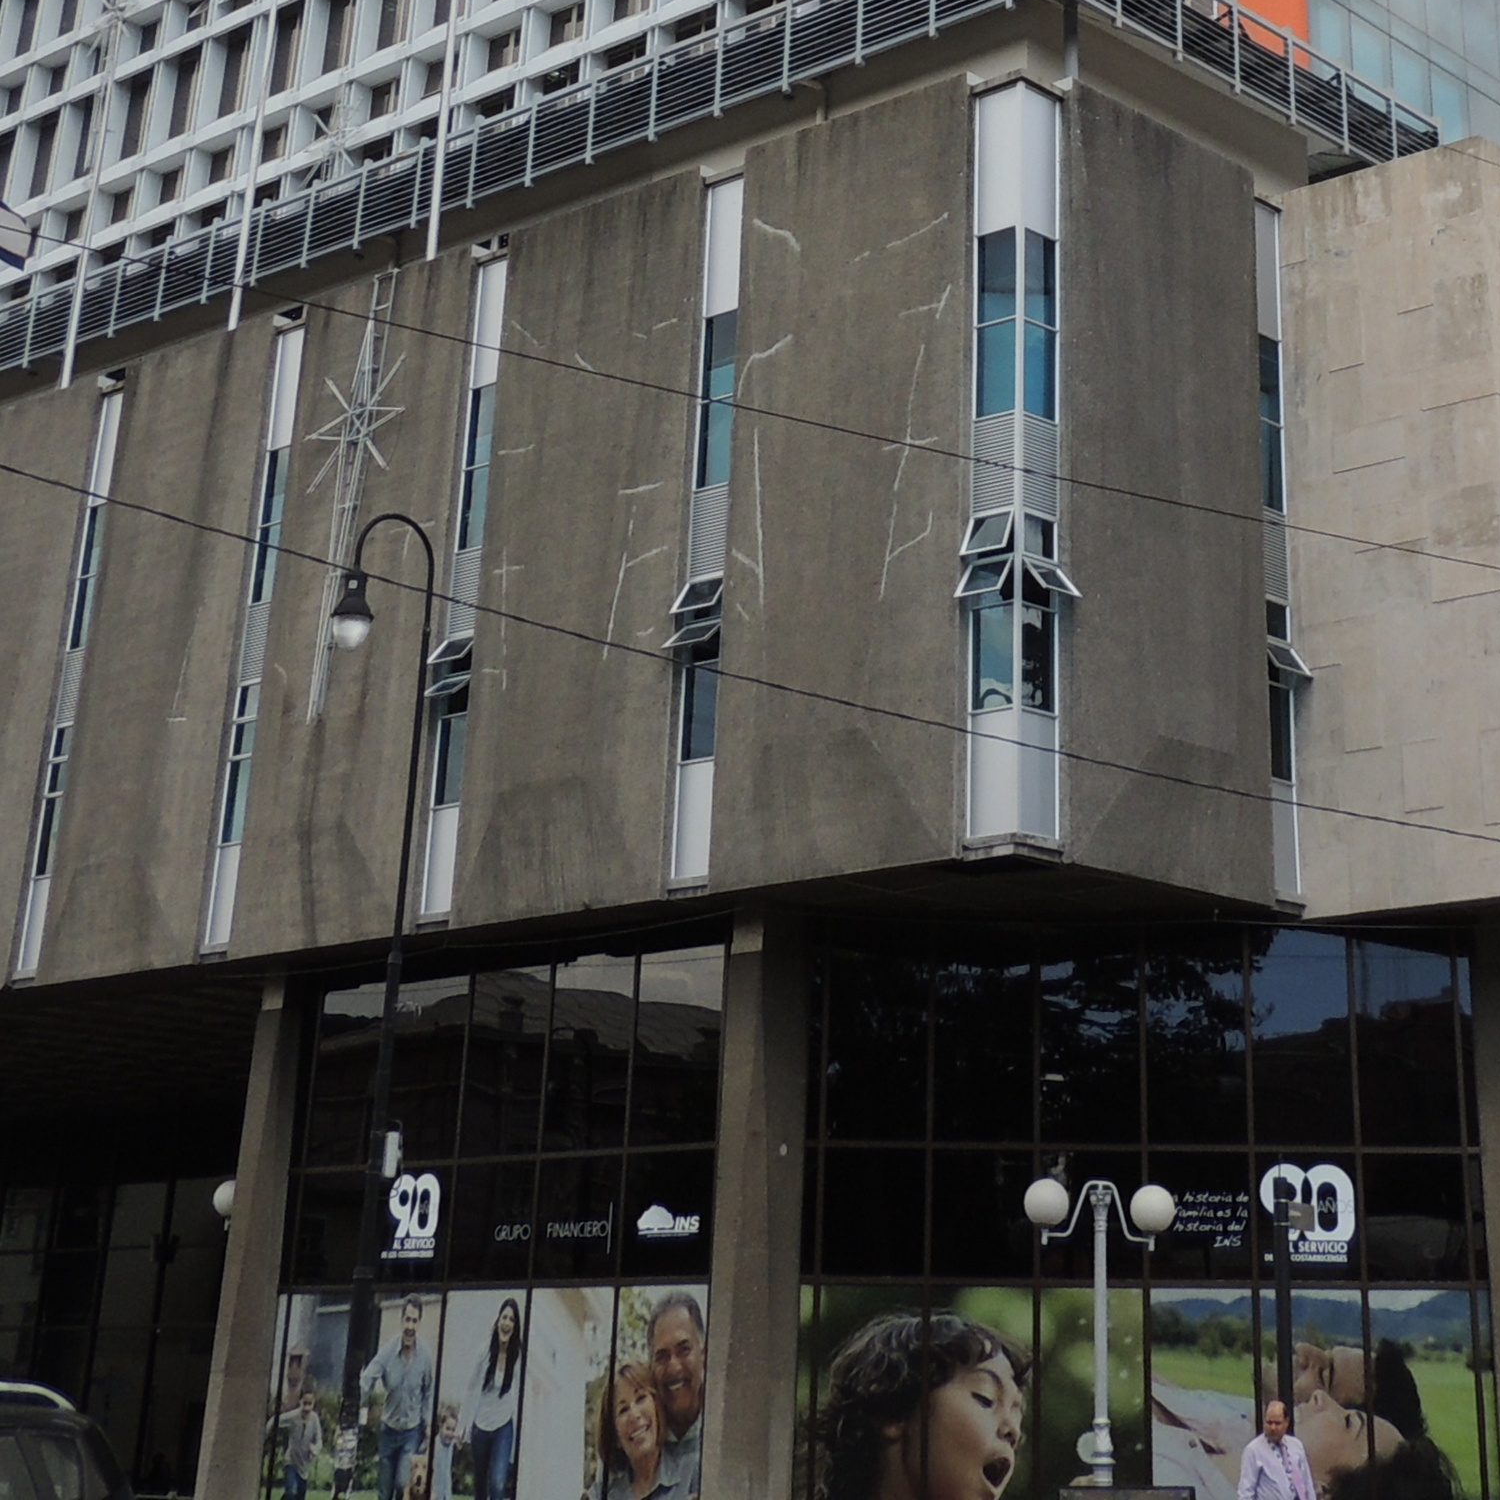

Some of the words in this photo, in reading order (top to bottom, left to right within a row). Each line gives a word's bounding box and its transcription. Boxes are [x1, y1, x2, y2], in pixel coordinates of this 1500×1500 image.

[1182, 1191, 1233, 1203] historia
[1236, 1191, 1250, 1203] de
[389, 1173, 440, 1238] 90
[1216, 1208, 1232, 1218] es
[1236, 1205, 1249, 1218] la
[675, 1215, 700, 1231] INS
[1173, 1220, 1224, 1232] historia
[1227, 1220, 1247, 1232] del
[494, 1224, 531, 1241] GRUPO
[546, 1220, 609, 1238] FINANCIERO
[1213, 1234, 1242, 1248] INS
[1298, 1241, 1349, 1254] SERVICIO
